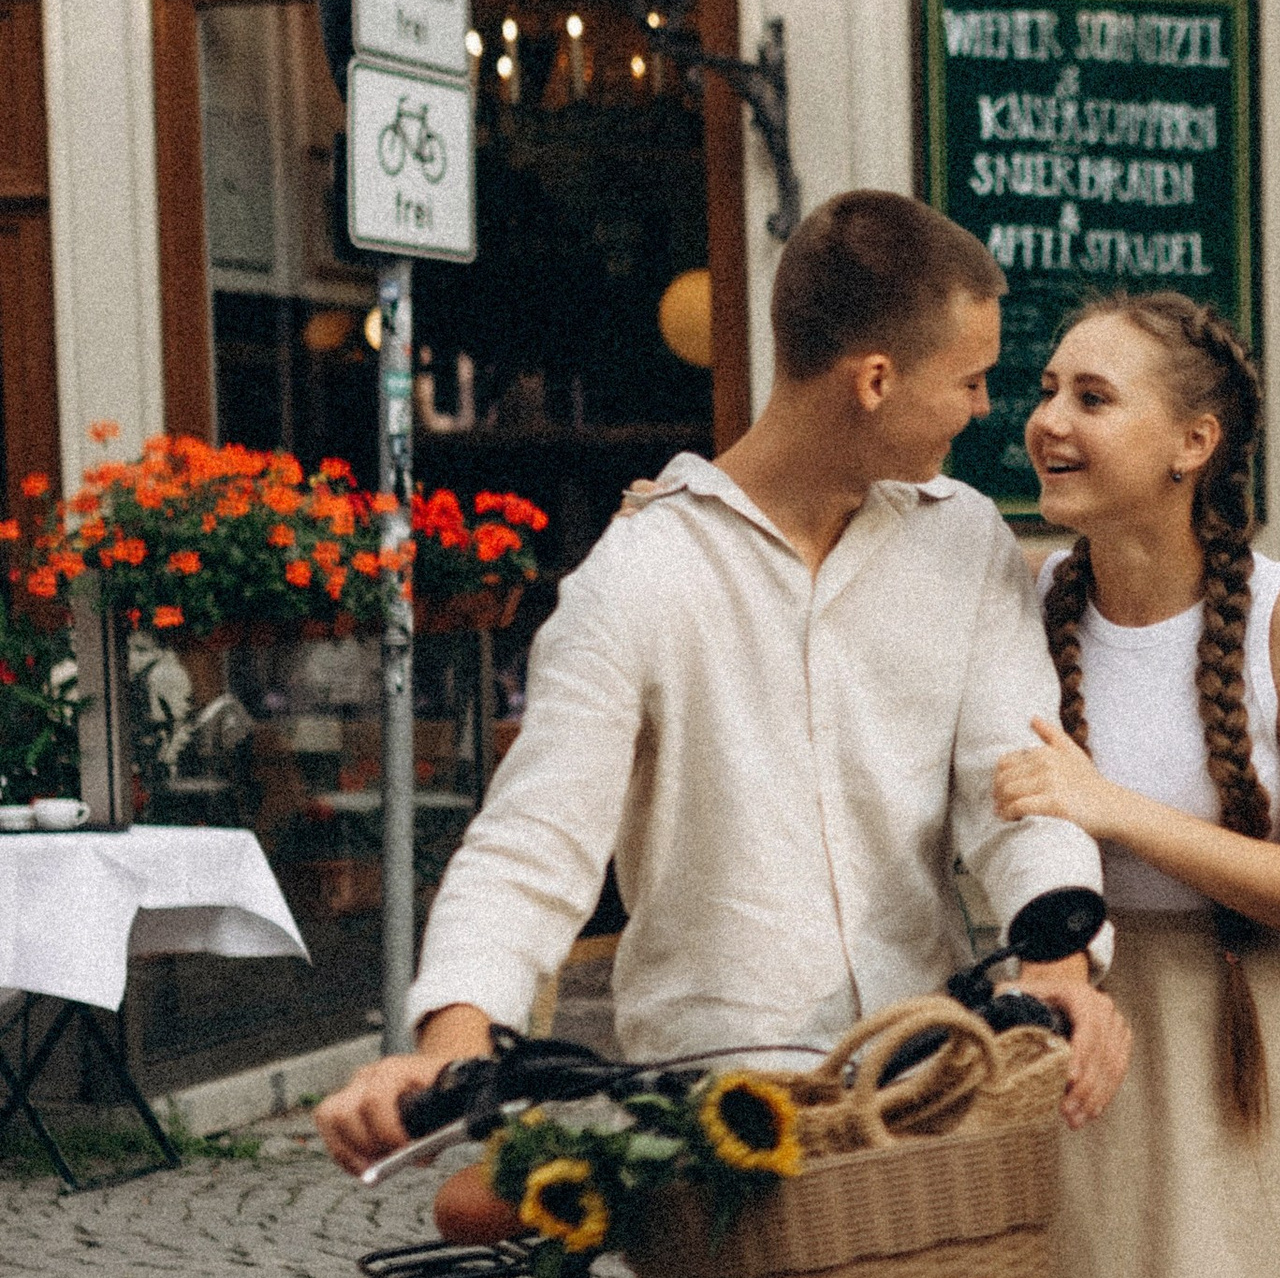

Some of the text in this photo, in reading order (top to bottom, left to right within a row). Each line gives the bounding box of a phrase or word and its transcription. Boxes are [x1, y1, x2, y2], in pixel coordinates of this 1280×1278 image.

[943, 8, 1230, 69] WIENER SCHNITZEL
[396, 189, 433, 230] frei
